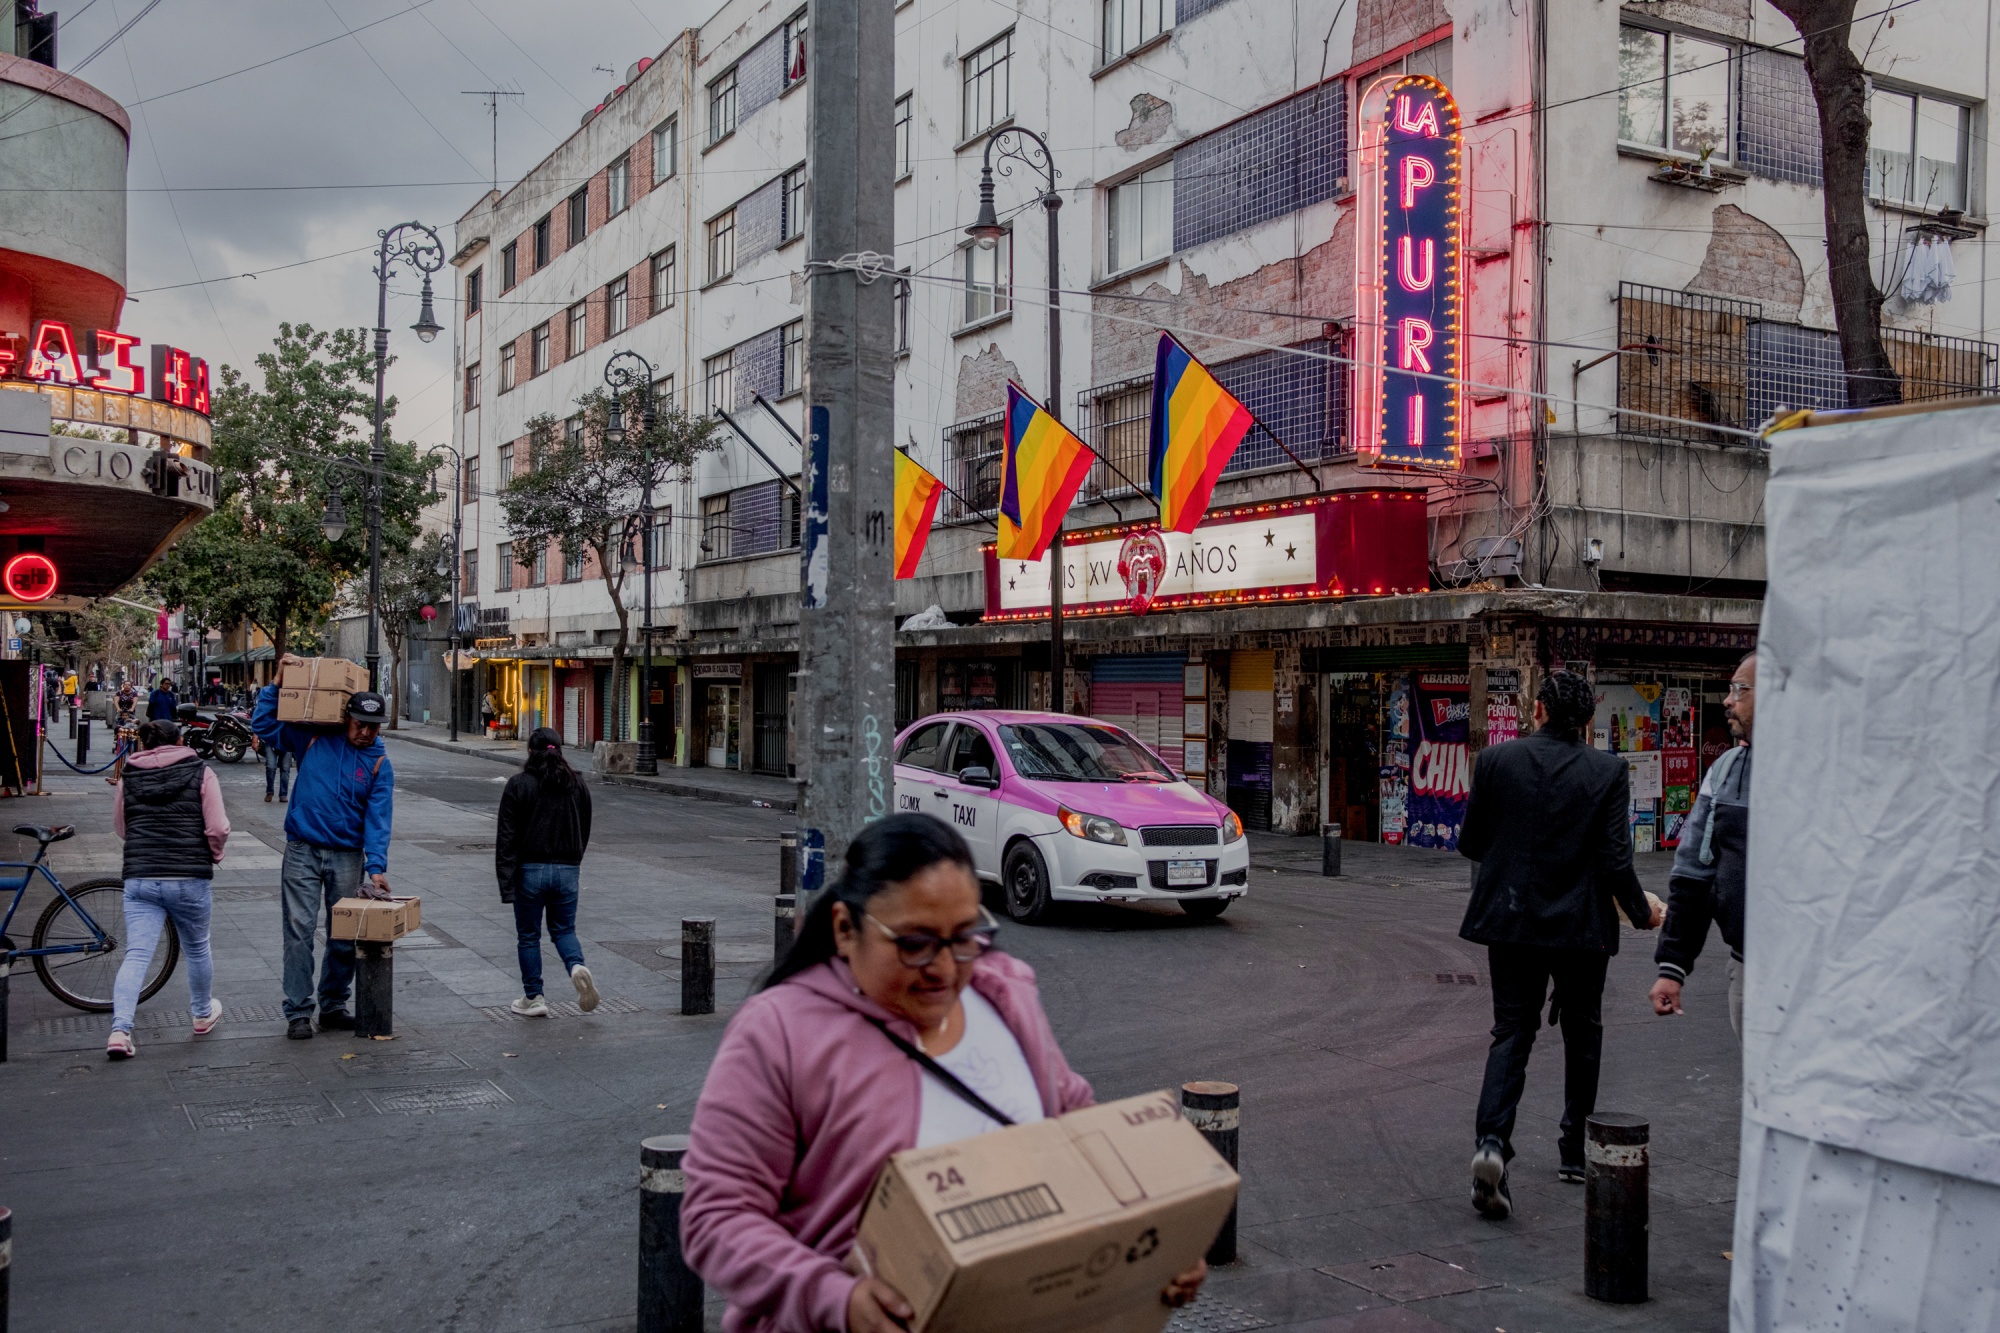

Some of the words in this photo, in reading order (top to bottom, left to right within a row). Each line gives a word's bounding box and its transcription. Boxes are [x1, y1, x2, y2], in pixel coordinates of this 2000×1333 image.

[1397, 94, 1440, 138] LA
[1397, 154, 1436, 447] PURI
[1047, 563, 1076, 590] IS
[1089, 559, 1112, 587] XV
[1174, 541, 1238, 578] AÑOS
[10, 640, 19, 649] E
[1487, 703, 1517, 718] PERMITO
[1494, 693, 1510, 706] NO
[899, 794, 921, 812] CDMX
[953, 803, 976, 827] TAXI
[926, 1166, 965, 1193] 24
